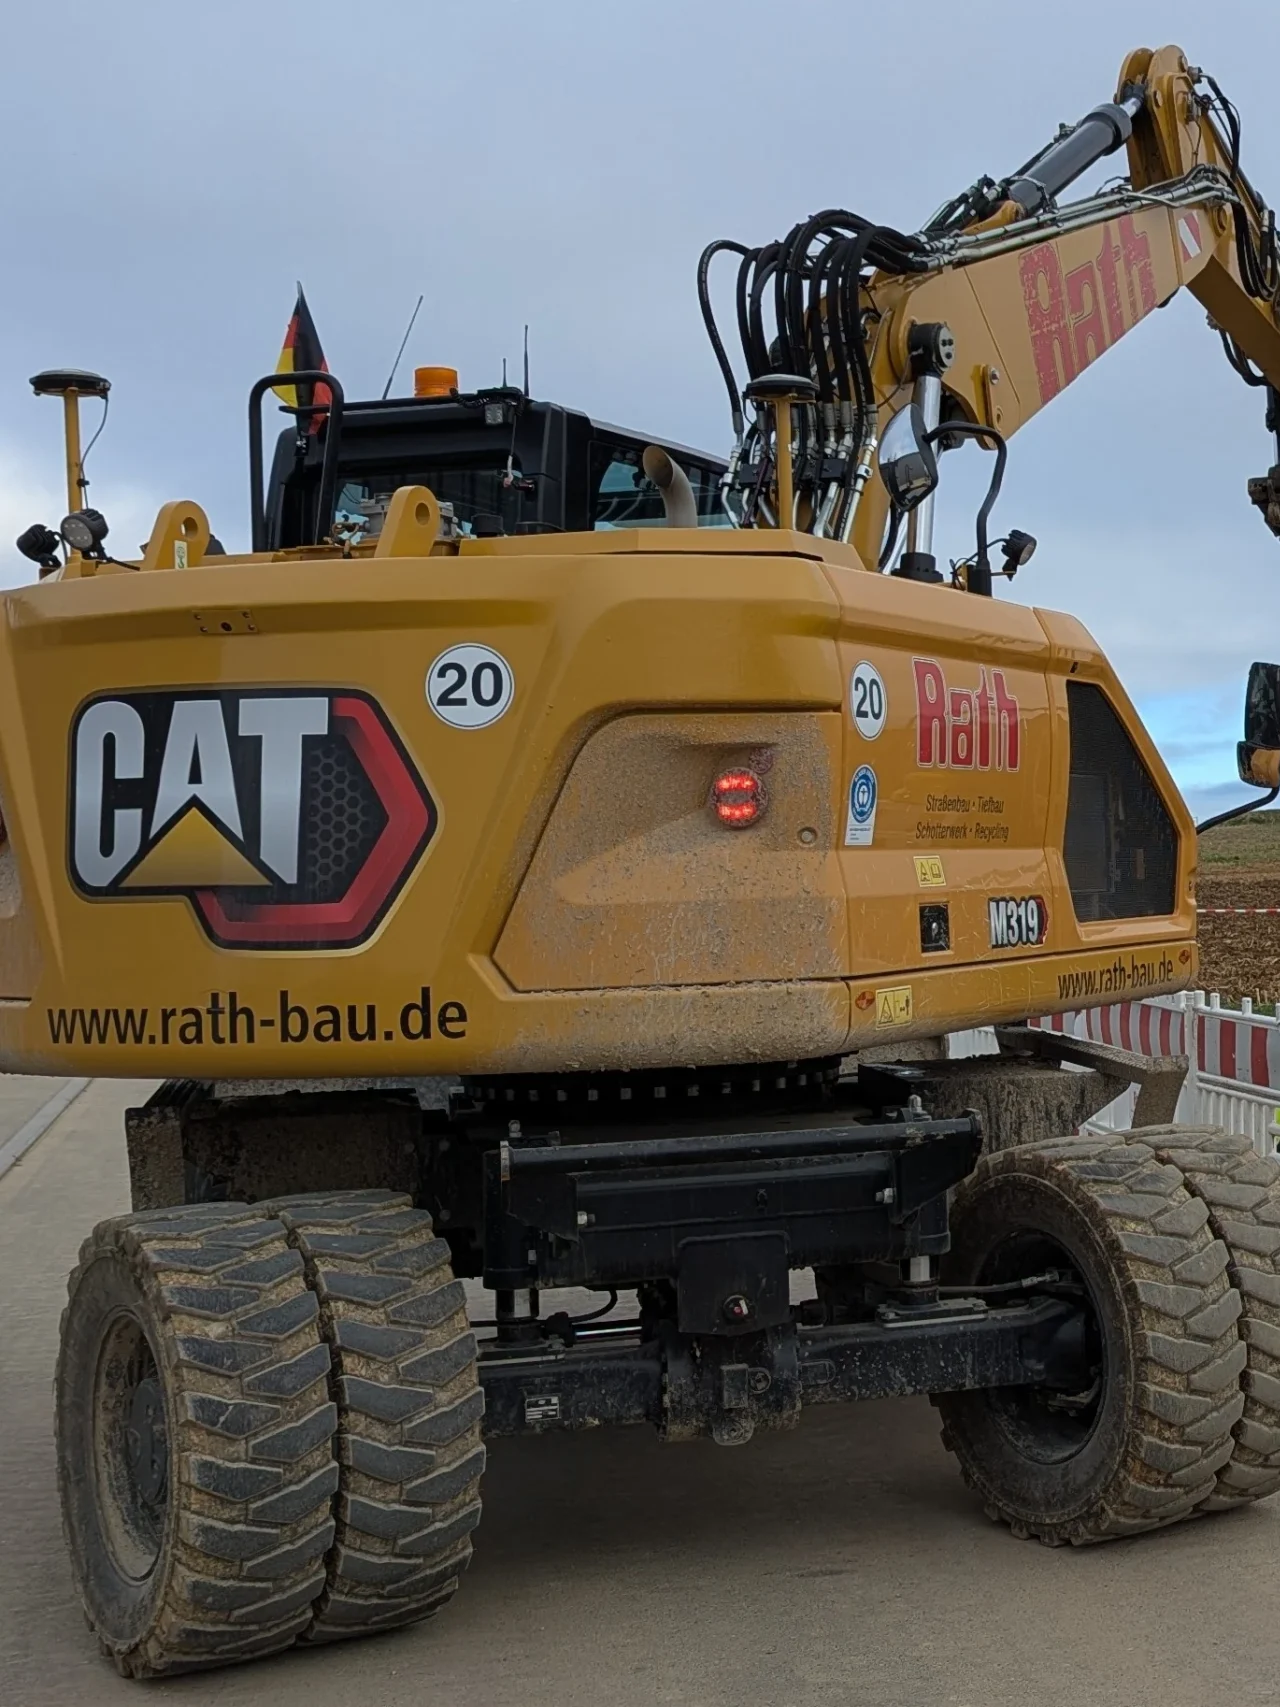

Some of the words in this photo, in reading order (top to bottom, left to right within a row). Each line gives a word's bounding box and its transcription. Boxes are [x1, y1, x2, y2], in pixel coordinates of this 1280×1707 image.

[1018, 214, 1158, 405] Rath
[436, 661, 504, 707] 20
[854, 676, 883, 721] 20
[912, 656, 1019, 772] Rath
[74, 696, 329, 888] CAT
[926, 794, 971, 813] Straßenbau
[977, 796, 1005, 814] Tiefbau
[915, 821, 968, 840] Schotterwerk
[974, 822, 1010, 843] Recycling
[989, 898, 1039, 946] M319
[1057, 951, 1174, 1000] www.rath-bau.de
[47, 986, 469, 1046] www.rath-bau.de
